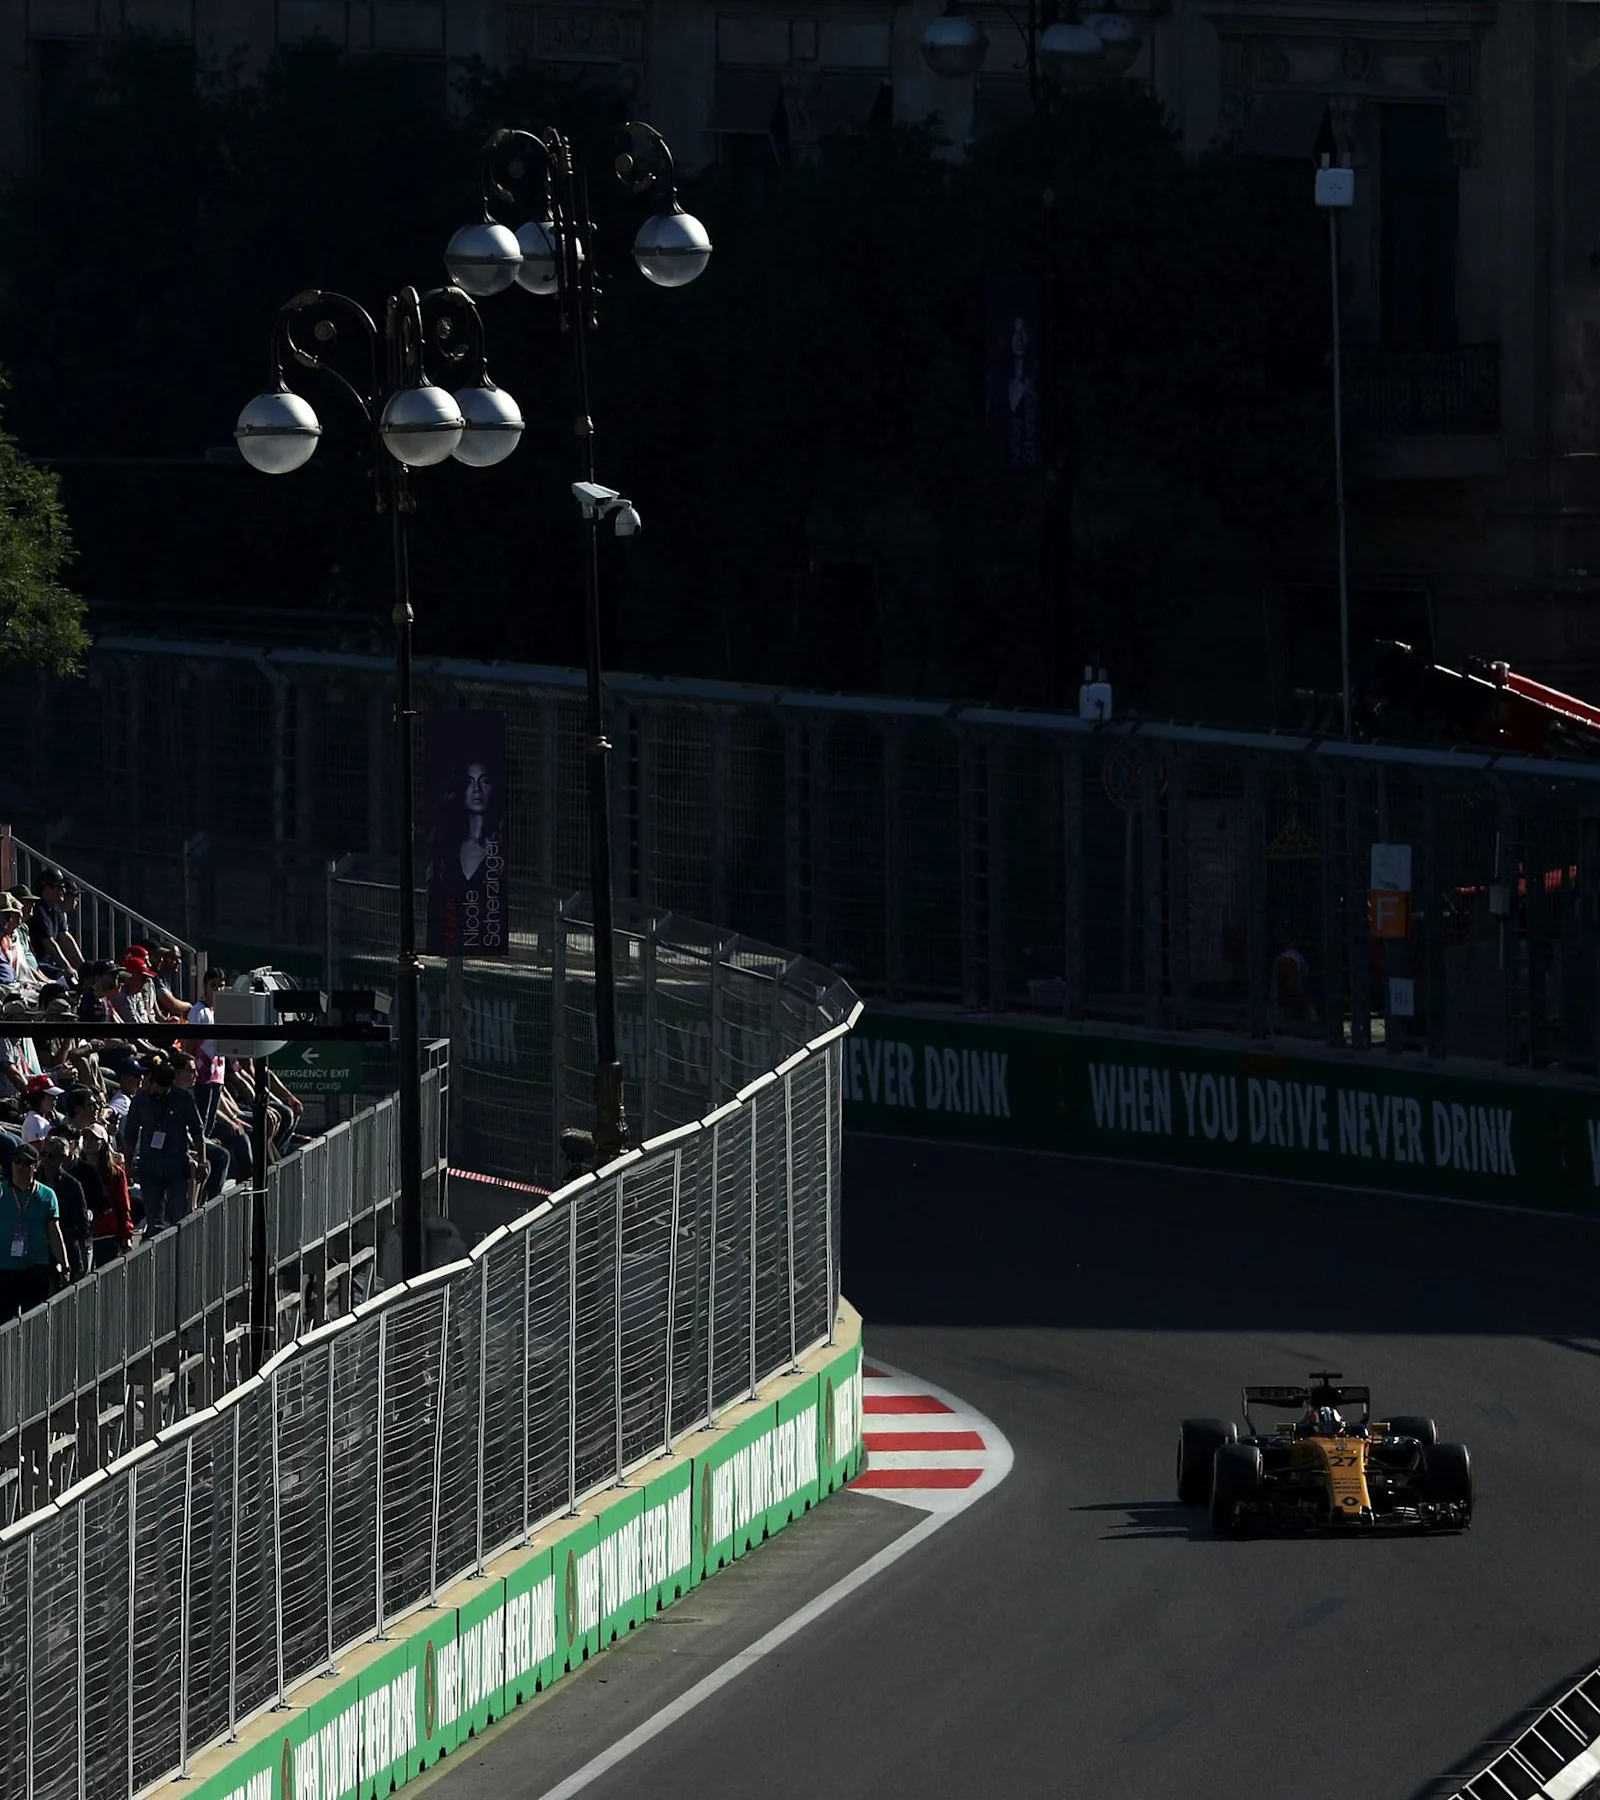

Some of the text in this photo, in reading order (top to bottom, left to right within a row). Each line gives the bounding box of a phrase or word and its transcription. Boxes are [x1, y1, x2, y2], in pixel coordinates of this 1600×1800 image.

[463, 889, 480, 947] Nicole
[483, 838, 505, 947] Scherzinger
[1376, 896, 1400, 932] F
[330, 1068, 351, 1078] EXIT
[924, 1045, 1012, 1118] DRINK
[1089, 1061, 1173, 1136] WHEN
[1178, 1068, 1240, 1144] YOU
[1247, 1077, 1331, 1153] DRIVE
[1338, 1088, 1426, 1165] NEVER
[1431, 1100, 1517, 1177] DRINK
[734, 1446, 751, 1531] YOU
[1330, 1456, 1357, 1467] 27
[600, 1532, 618, 1620] YOU
[464, 1622, 481, 1713] YOU
